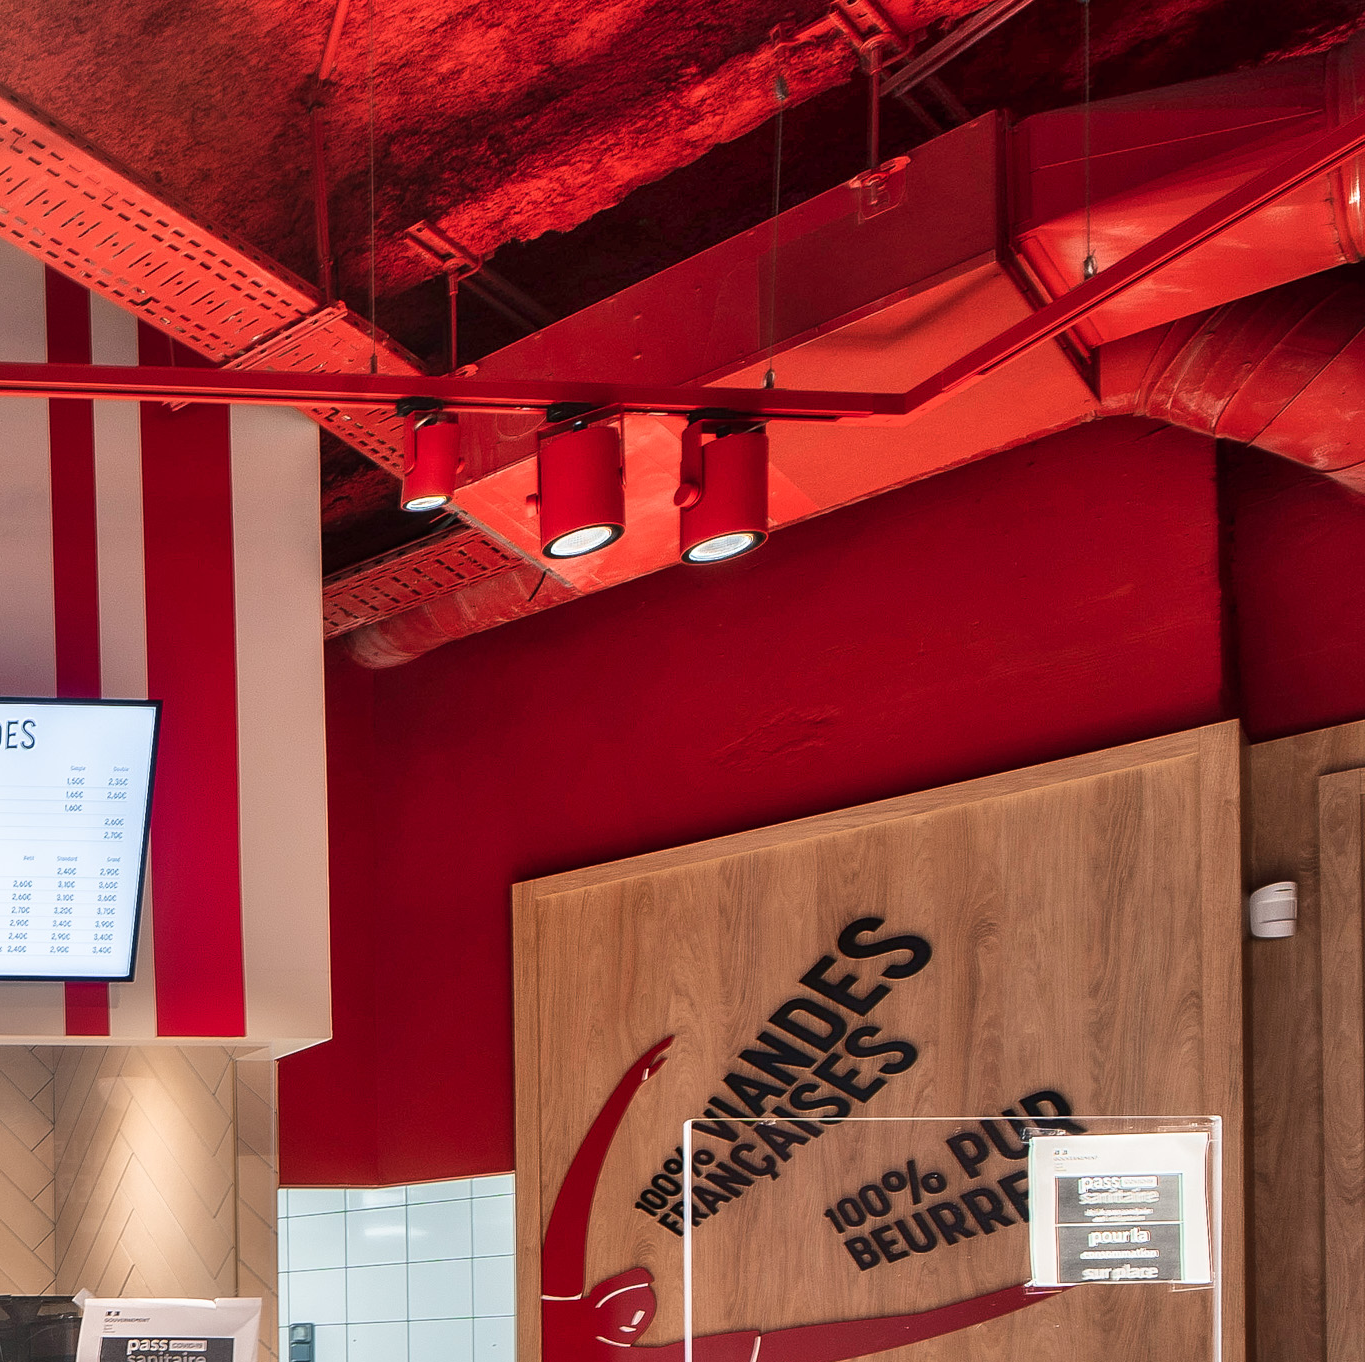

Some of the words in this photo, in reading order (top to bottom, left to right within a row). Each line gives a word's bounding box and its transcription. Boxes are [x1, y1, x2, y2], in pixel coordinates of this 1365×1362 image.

[692, 916, 933, 1144] VIANDES
[649, 1024, 918, 1238] FRANÇAISES
[823, 1160, 947, 1234] 100%
[946, 1090, 1087, 1180] PUR
[1079, 1178, 1119, 1194] pass
[1089, 1229, 1129, 1247] pour
[1130, 1228, 1150, 1242] la
[127, 1340, 168, 1355] pass
